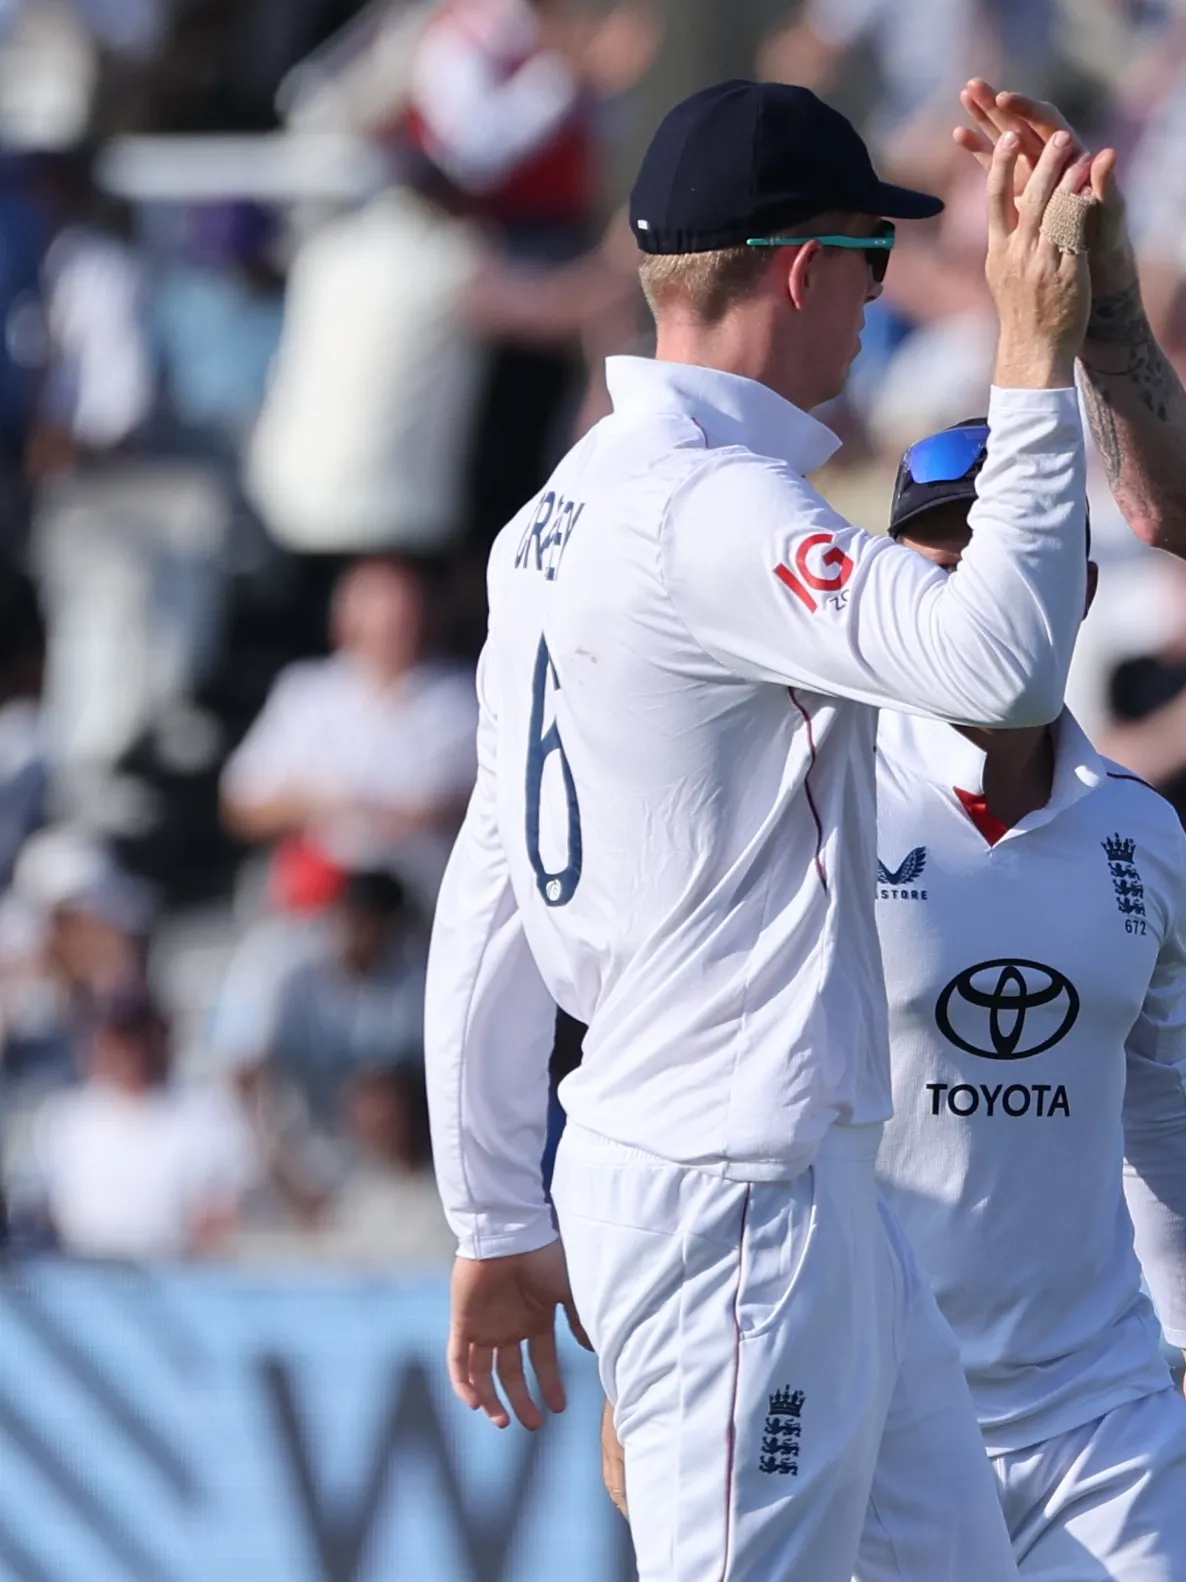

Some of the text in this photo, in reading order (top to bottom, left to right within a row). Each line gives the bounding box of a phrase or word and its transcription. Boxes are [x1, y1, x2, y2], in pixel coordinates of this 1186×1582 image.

[525, 630, 582, 907] 6
[875, 889, 928, 900] STORE
[1125, 919, 1146, 936] 672
[926, 1083, 1070, 1117] TOYOTA
